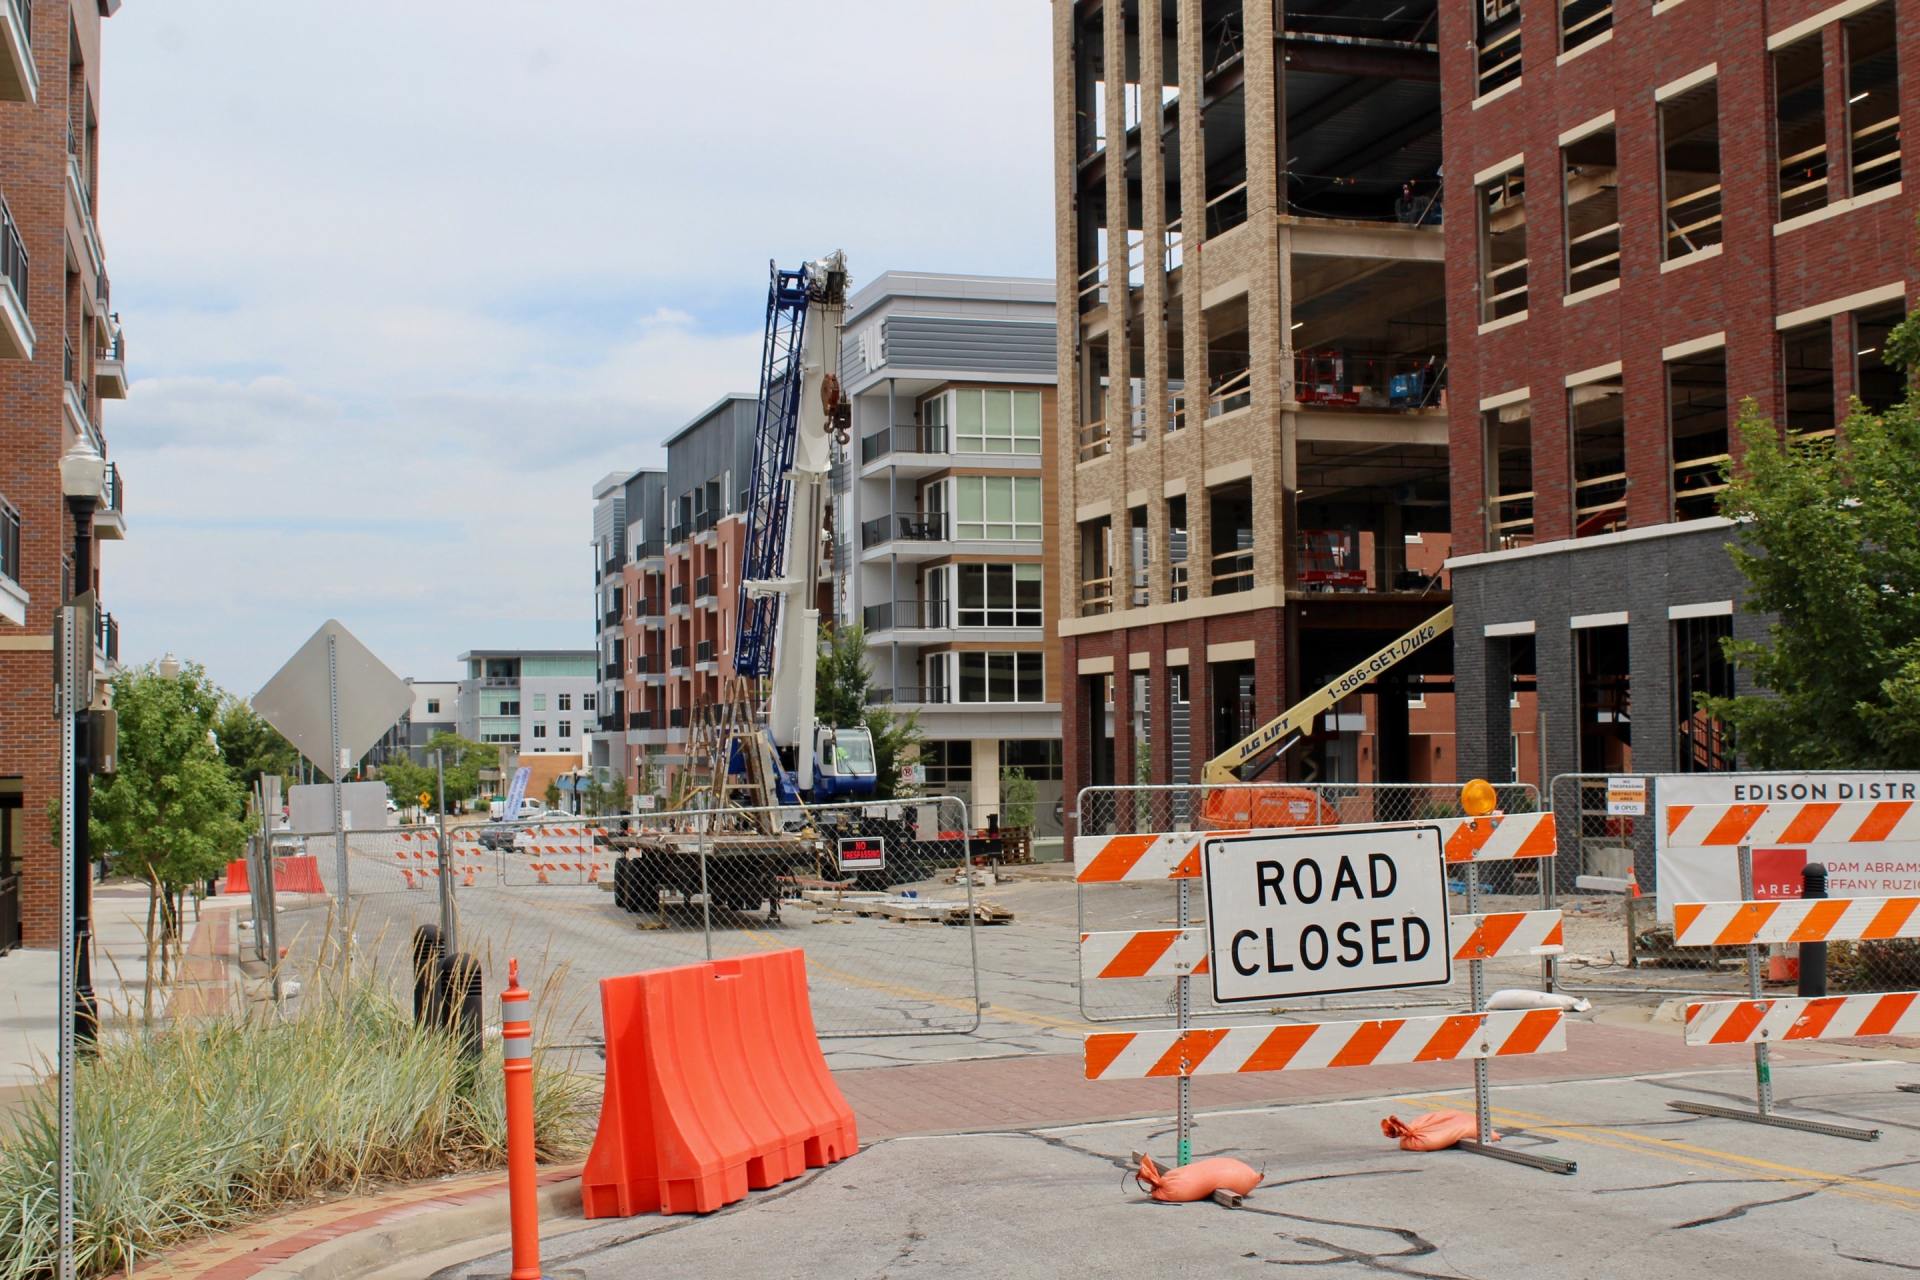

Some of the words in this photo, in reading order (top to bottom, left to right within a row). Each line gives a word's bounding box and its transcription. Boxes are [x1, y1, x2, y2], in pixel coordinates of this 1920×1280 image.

[1240, 737, 1260, 759] JLG
[1263, 717, 1289, 742] LIFT
[1734, 783, 1827, 801] EDISON
[1838, 782, 1916, 800] DISTR
[855, 841, 866, 850] NO
[842, 849, 880, 859] TRESPASSING
[1821, 862, 1860, 872] DAM
[1256, 853, 1397, 907] ROAD
[1826, 879, 1877, 889] IFFANY
[1882, 879, 1920, 890] RUZI
[1757, 884, 1803, 895] AREA
[1231, 916, 1431, 977] CLOSED
